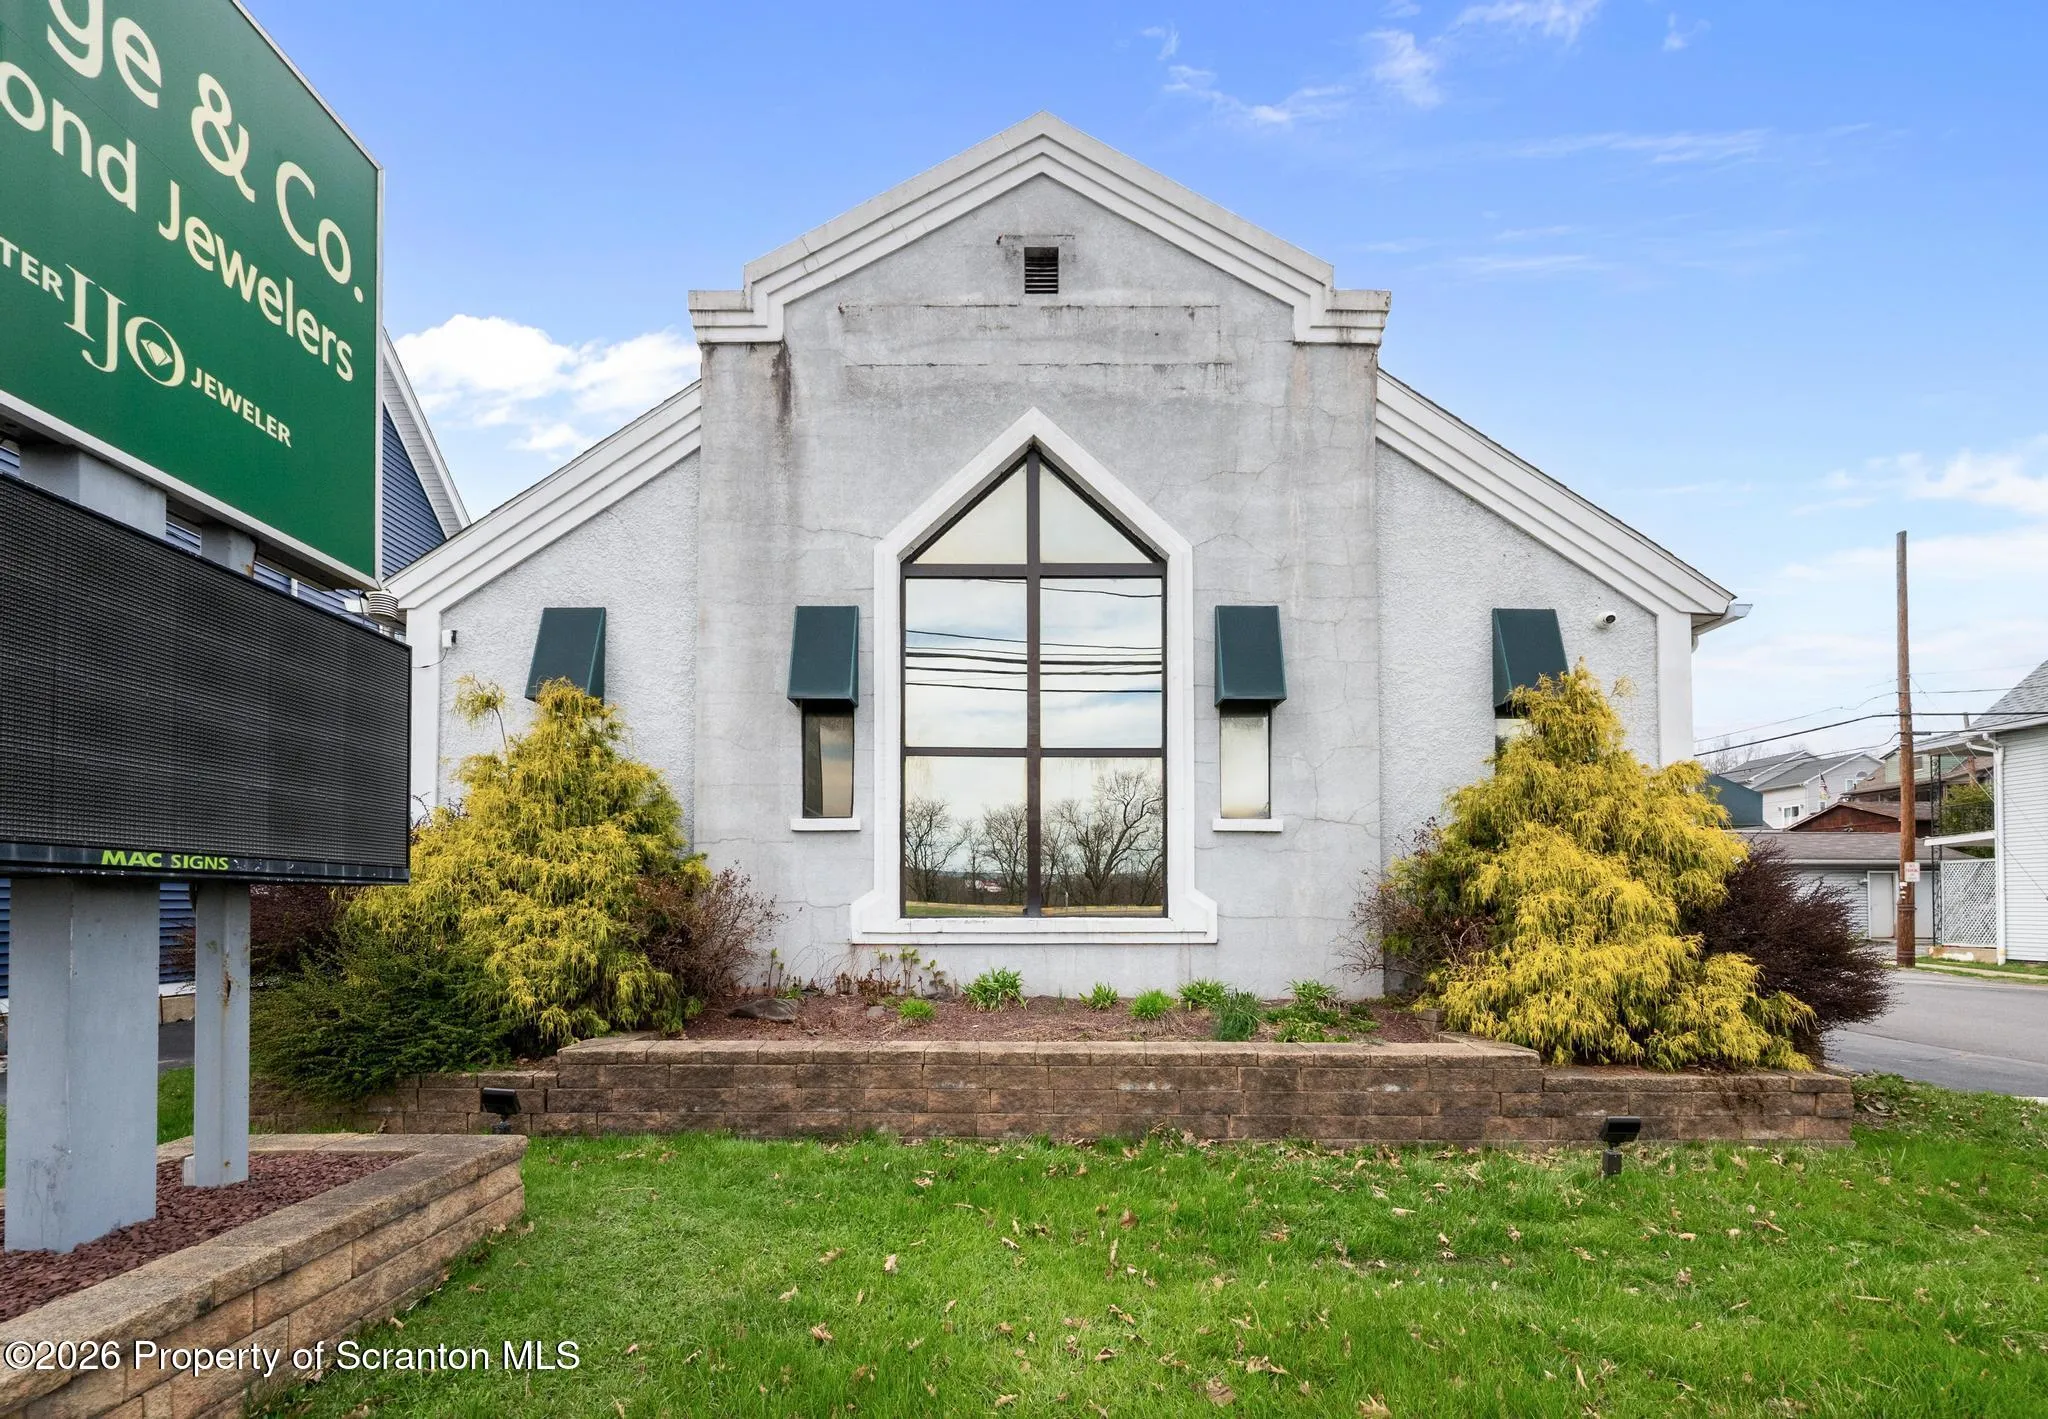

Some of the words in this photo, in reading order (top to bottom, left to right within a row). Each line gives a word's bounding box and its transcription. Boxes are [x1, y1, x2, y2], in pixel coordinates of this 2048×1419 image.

[0, 61, 137, 213] ond
[158, 180, 354, 382] Jewelers
[191, 73, 255, 203] &
[276, 161, 364, 303] Co.
[0, 236, 64, 302] TER
[64, 263, 186, 387] IJO
[191, 367, 292, 448] JEWELER
[101, 850, 162, 867] MAC
[170, 854, 229, 870] SIGNS
